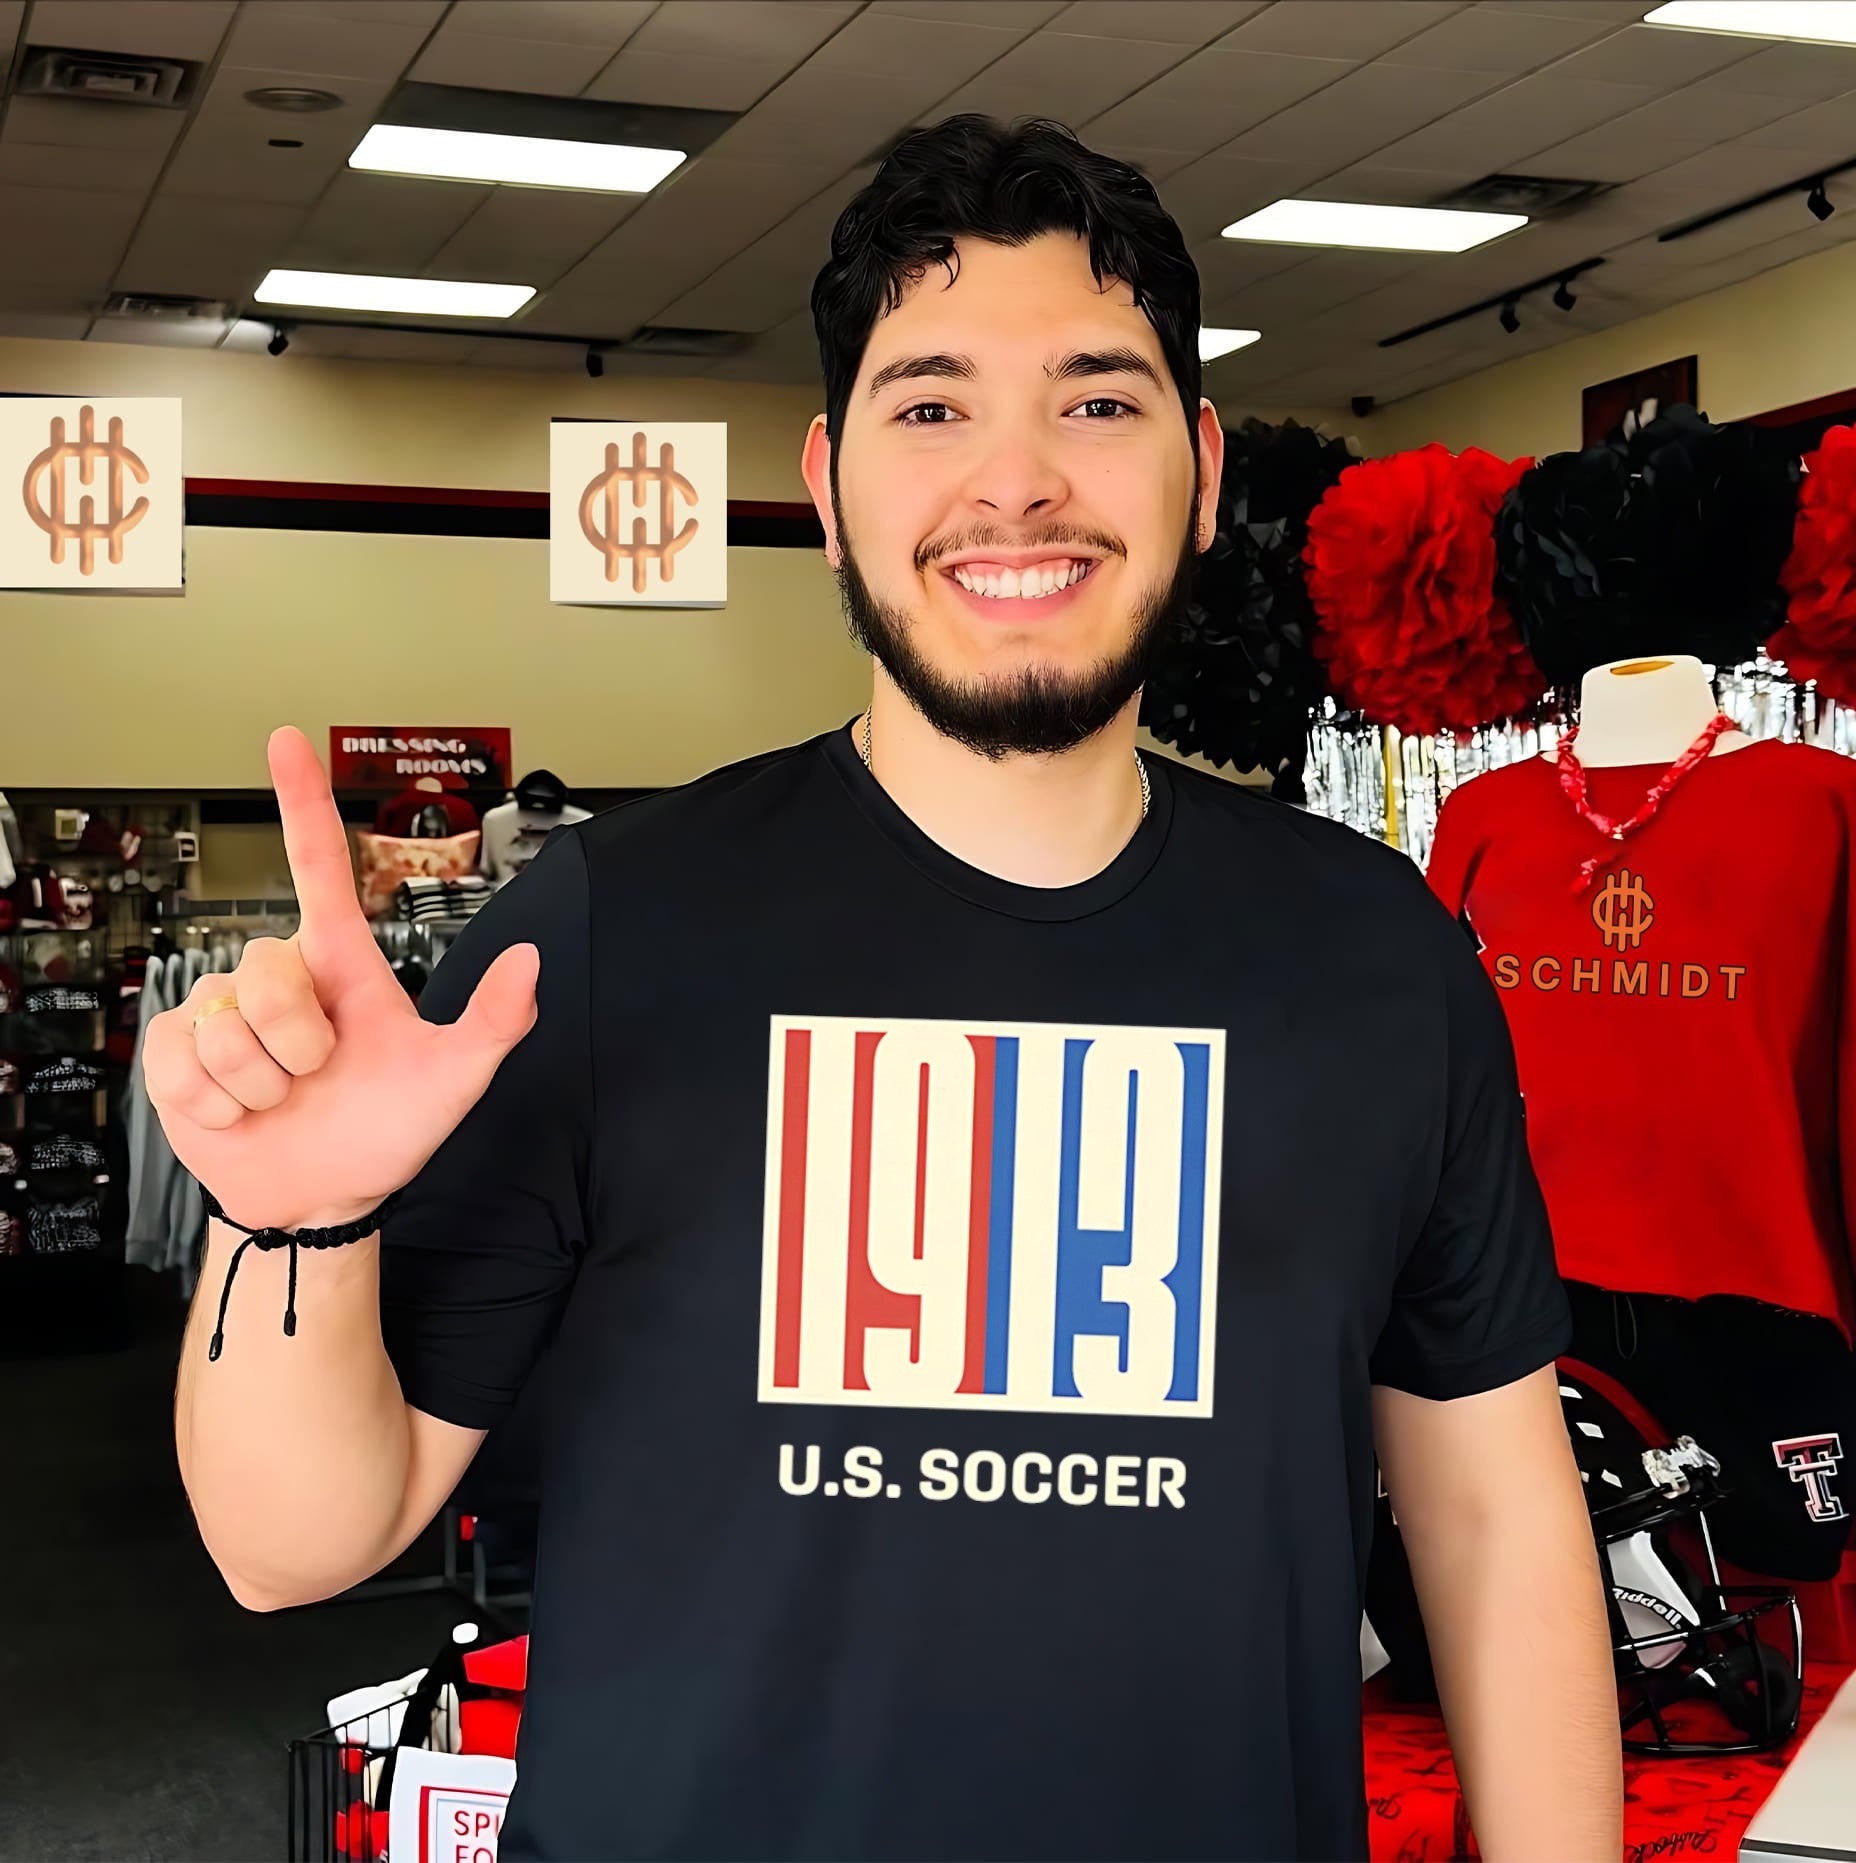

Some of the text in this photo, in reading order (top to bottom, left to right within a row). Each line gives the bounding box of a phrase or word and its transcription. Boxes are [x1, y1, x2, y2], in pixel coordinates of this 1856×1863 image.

[396, 758, 487, 775] ROOMS
[1494, 953, 1748, 1001] SCHMIDT
[782, 1024, 1205, 1406] 1913
[779, 1443, 1187, 1510] U.S. SOCCER
